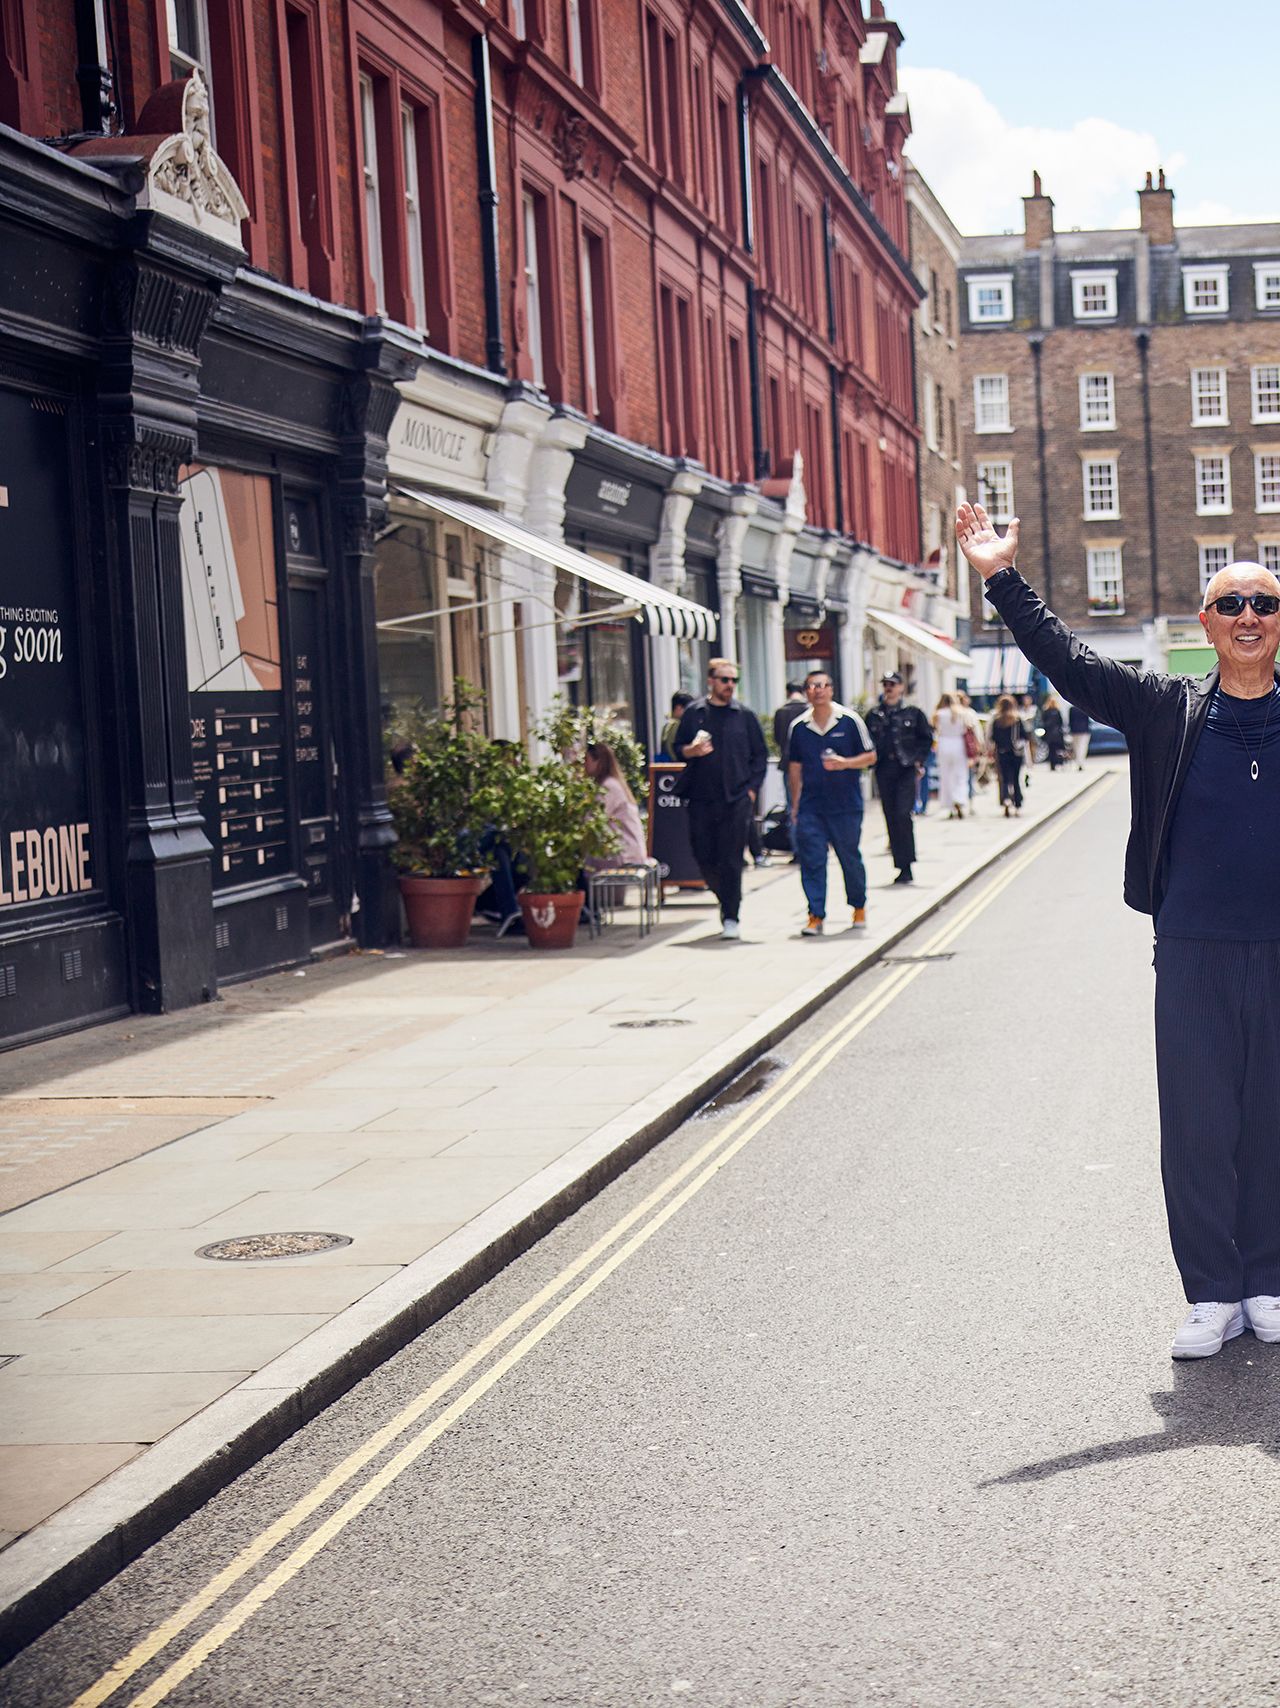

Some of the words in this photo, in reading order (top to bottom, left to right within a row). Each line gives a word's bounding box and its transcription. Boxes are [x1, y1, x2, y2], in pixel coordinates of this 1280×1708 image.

[400, 417, 466, 461] MONOCLE
[25, 608, 58, 623] EXCITING
[13, 626, 63, 663] soon
